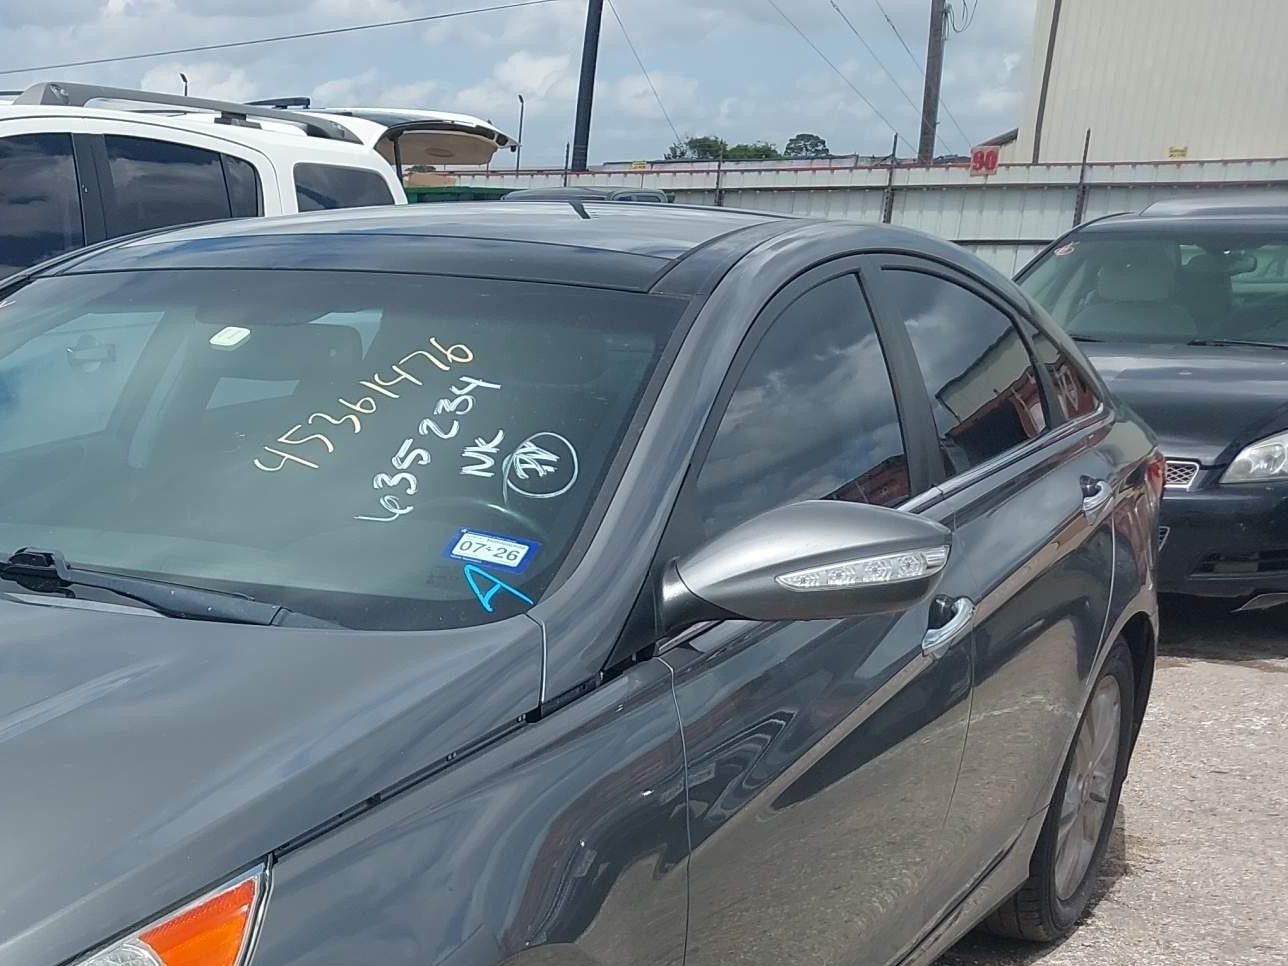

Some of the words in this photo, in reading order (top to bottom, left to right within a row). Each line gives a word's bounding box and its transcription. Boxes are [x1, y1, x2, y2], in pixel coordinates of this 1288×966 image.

[973, 150, 996, 170] 90
[253, 336, 474, 470] 45361476
[464, 564, 534, 612] A
